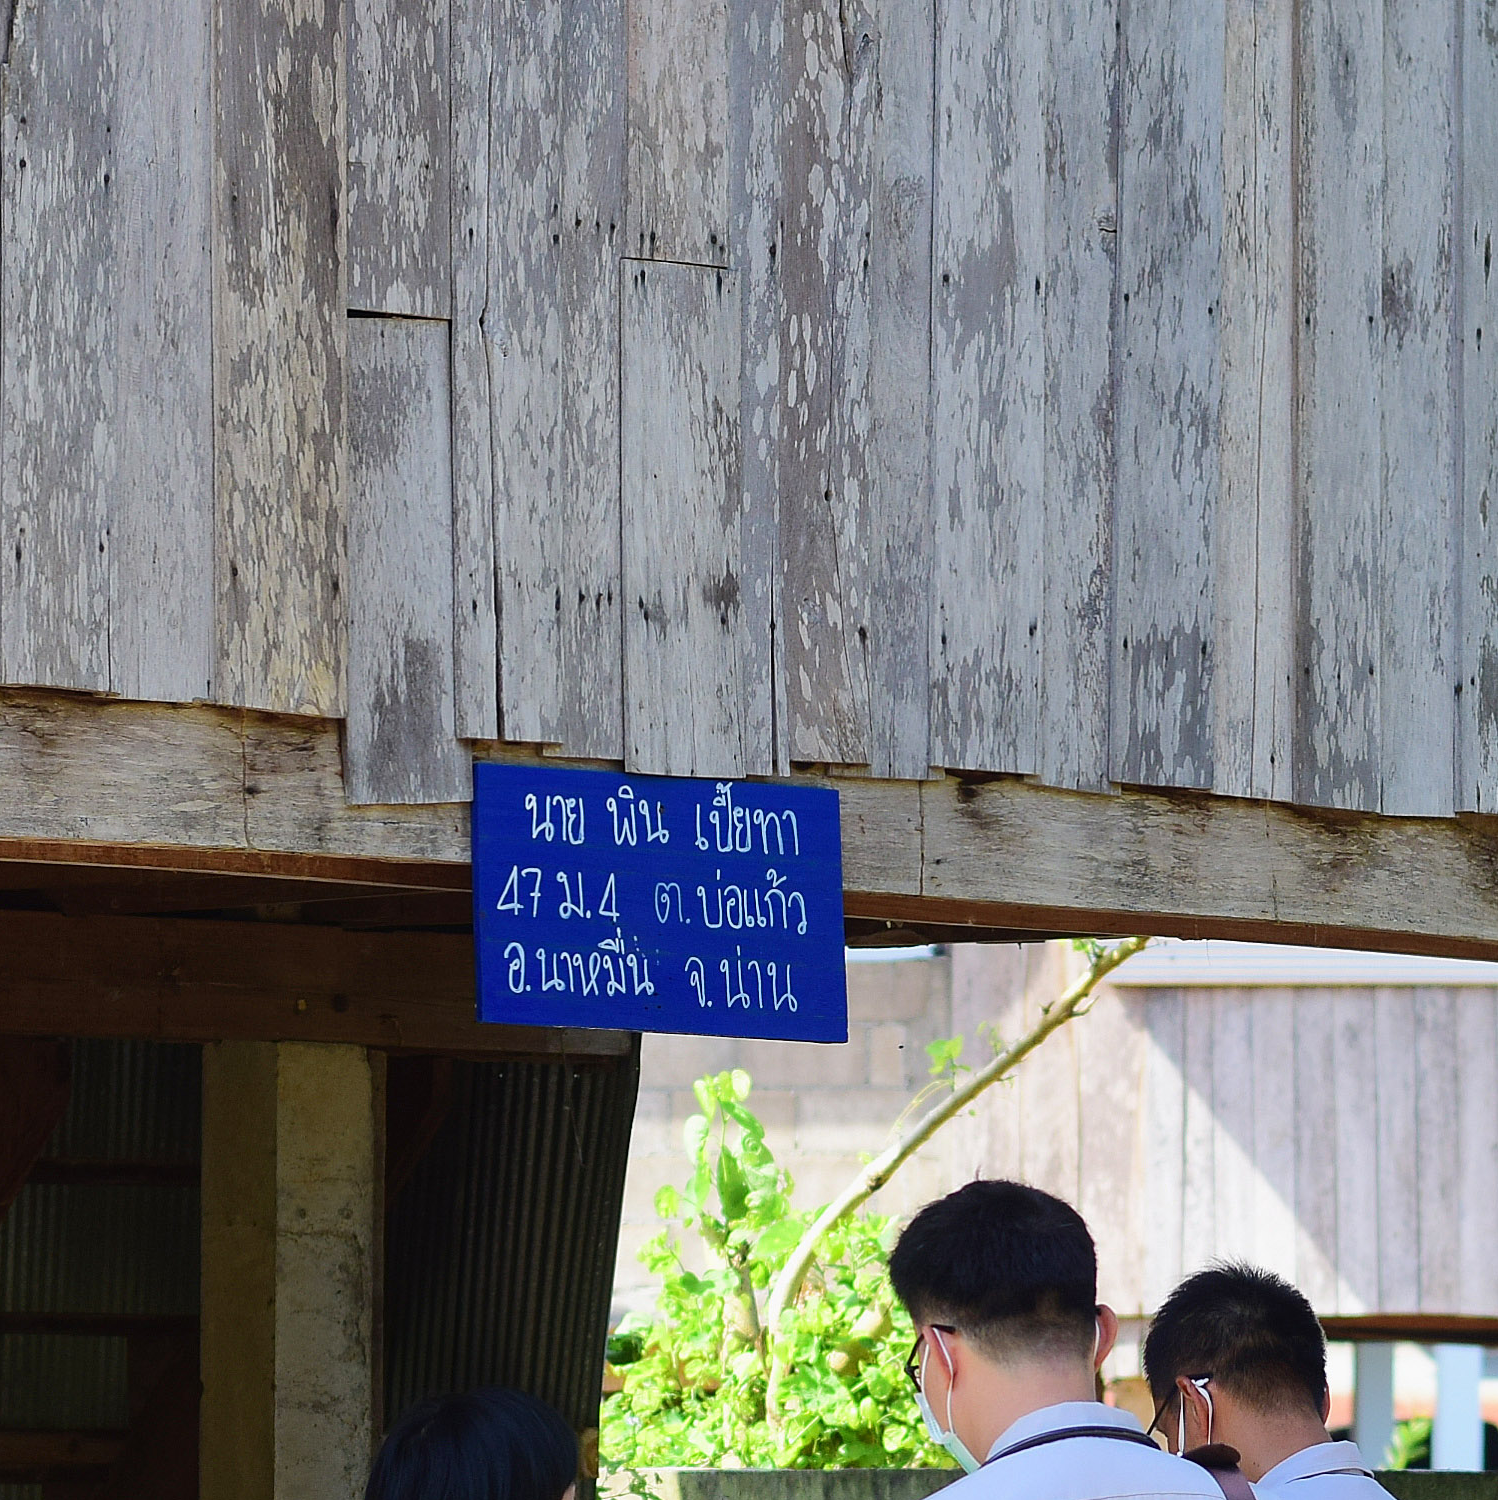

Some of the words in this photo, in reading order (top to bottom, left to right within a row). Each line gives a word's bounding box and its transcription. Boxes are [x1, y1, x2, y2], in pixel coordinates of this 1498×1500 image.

[525, 793, 585, 845] นาย
[606, 785, 670, 846] พิน
[694, 782, 799, 856] เปี้ยทา
[496, 865, 542, 917] 47
[557, 870, 620, 922] ม.4
[654, 868, 807, 935] ต.บ่อแก้ว
[504, 928, 655, 997] อ.นาหมื่น
[685, 946, 798, 1012] จ.น่าน
